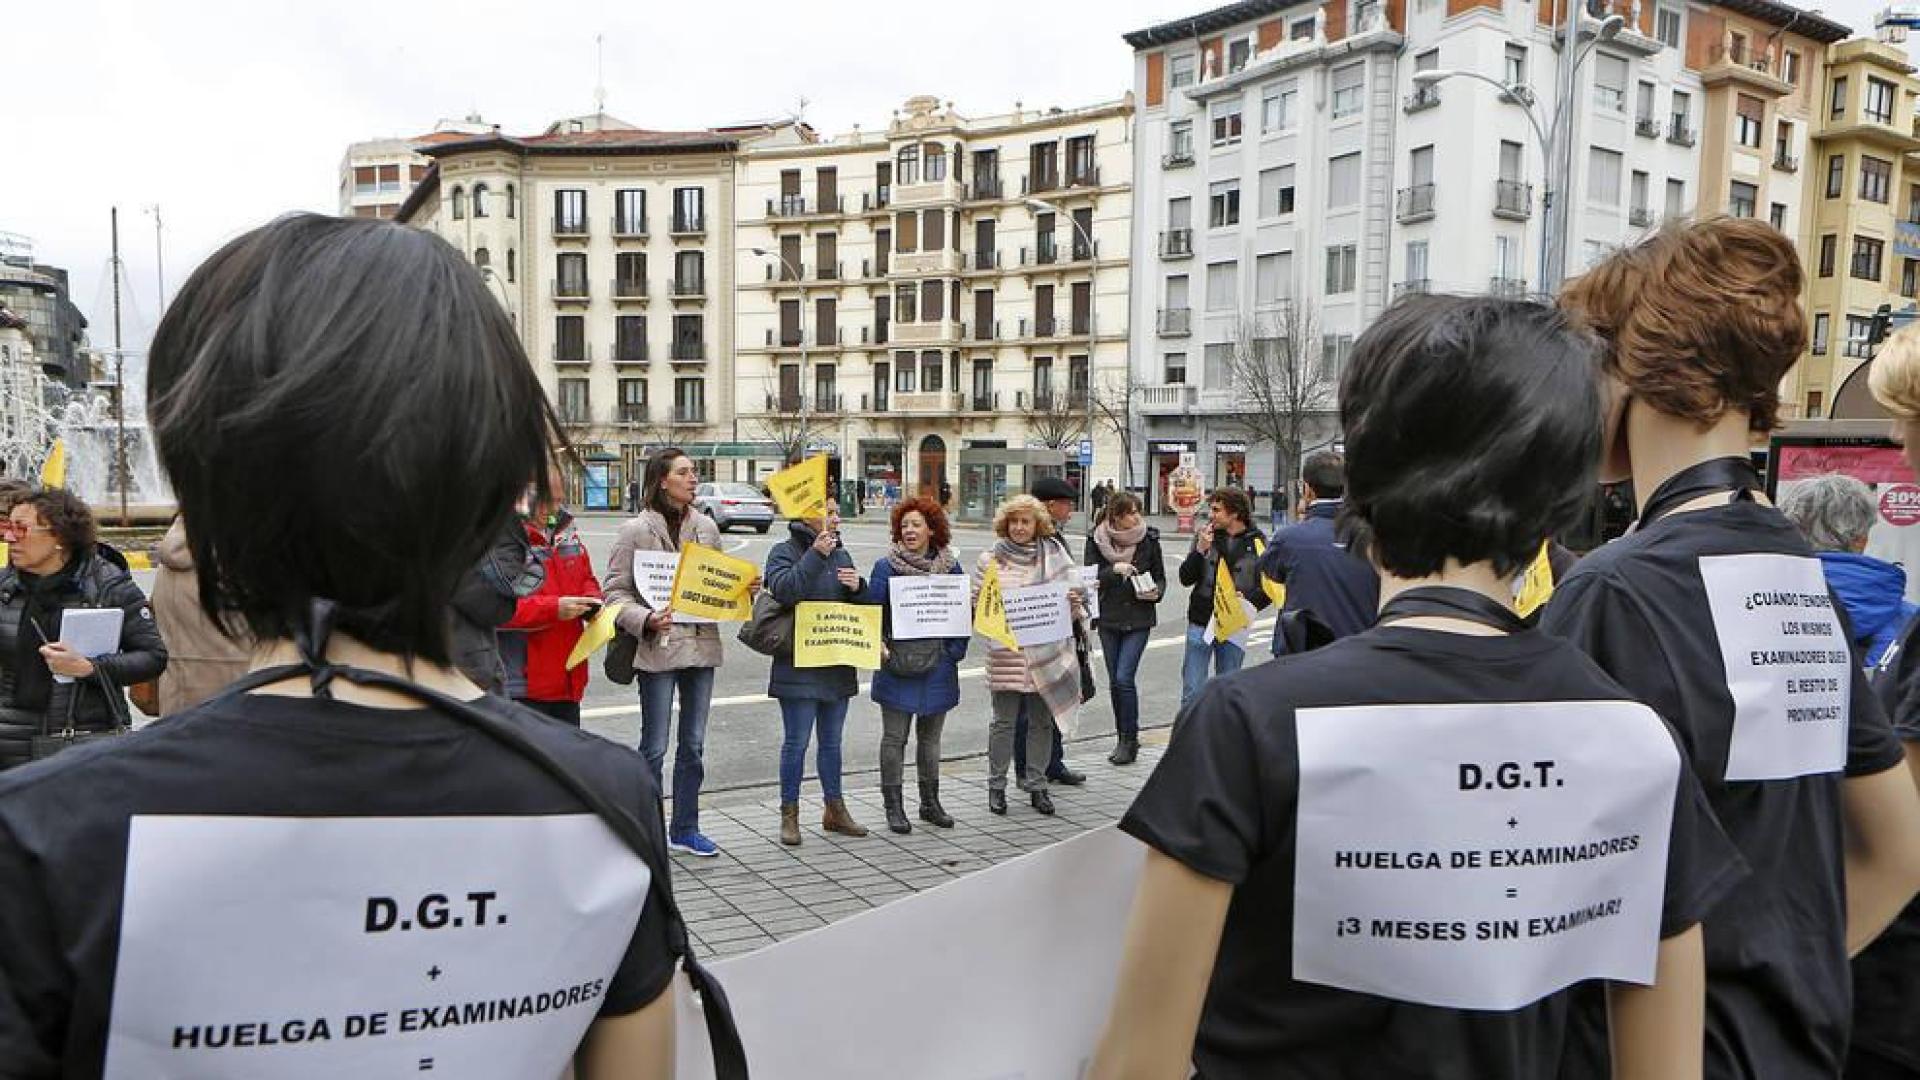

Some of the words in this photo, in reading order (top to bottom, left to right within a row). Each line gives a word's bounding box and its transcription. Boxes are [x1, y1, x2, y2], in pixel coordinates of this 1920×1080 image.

[1745, 590, 1799, 610] ¿CUÁNDO
[1781, 620, 1800, 635] LOS
[1750, 650, 1826, 666] EXAMINADORES
[1458, 760, 1565, 791] D.G.T.
[1334, 850, 1443, 871] HUELGA
[1449, 850, 1482, 870] DE
[1489, 834, 1641, 869] EXAMINADORES
[364, 890, 508, 935] D.G.T.
[1336, 916, 1362, 939] ¡3
[1369, 919, 1468, 942] MESES
[1474, 919, 1520, 942] SIN
[1526, 897, 1624, 940] EXAMINAR!
[170, 1016, 332, 1050] HUELGA
[343, 1010, 390, 1040] DE
[398, 977, 605, 1033] EXAMINADORES
